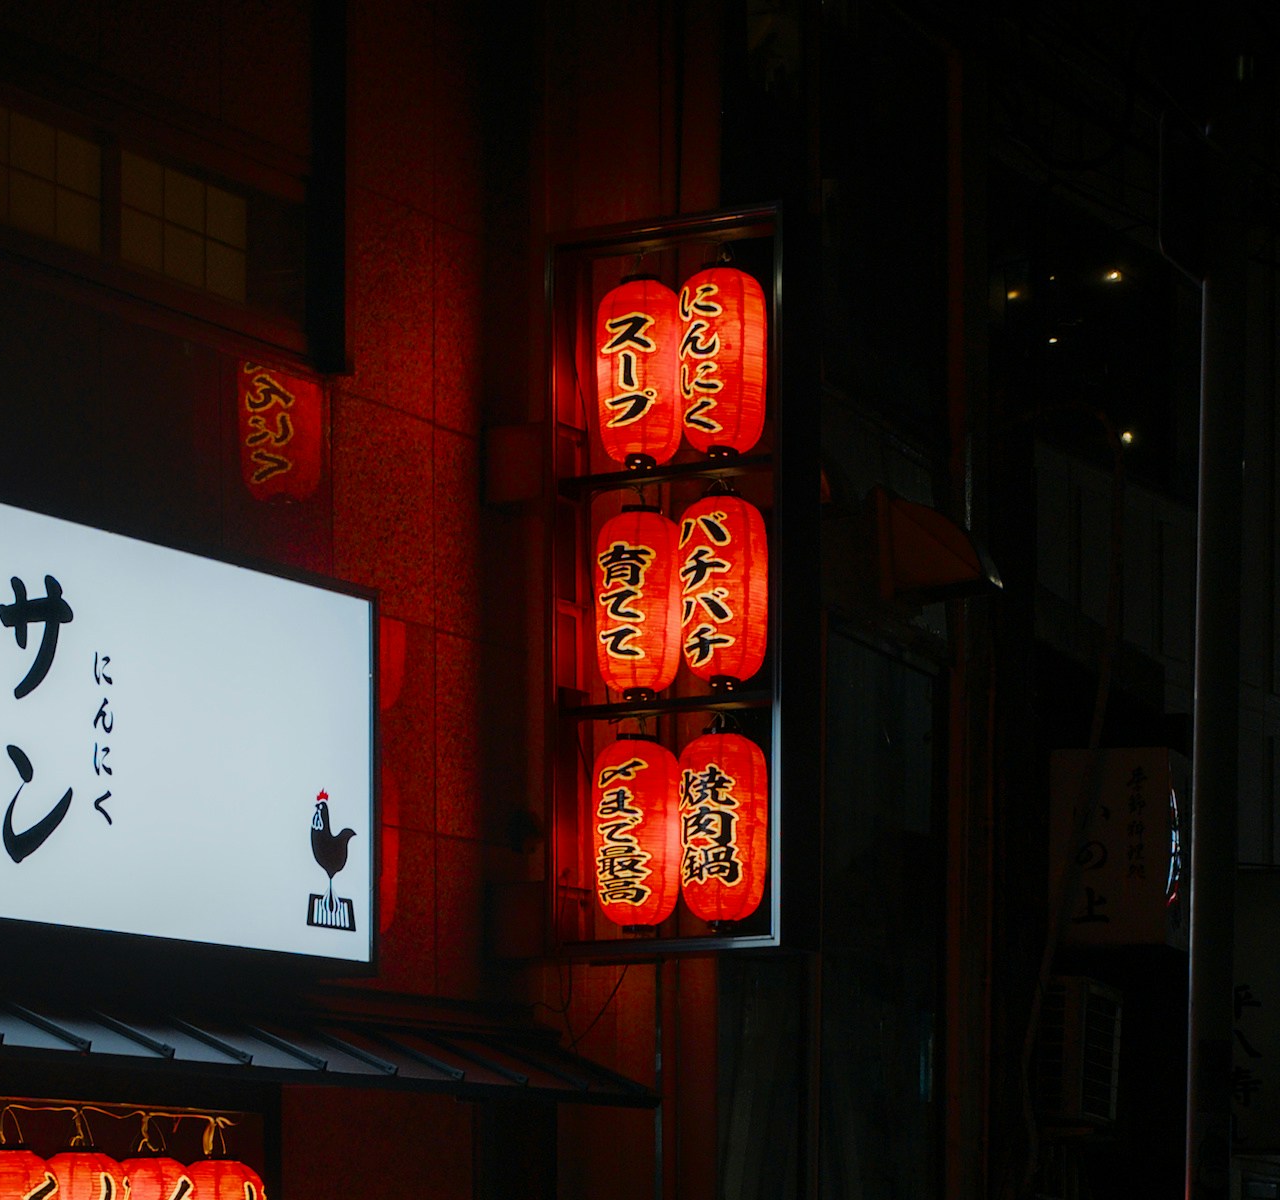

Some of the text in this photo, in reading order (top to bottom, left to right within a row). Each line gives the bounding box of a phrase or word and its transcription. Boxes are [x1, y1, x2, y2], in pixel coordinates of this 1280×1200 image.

[601, 312, 658, 429] スープ
[679, 284, 724, 433] にんにく
[597, 541, 657, 660] 育てて
[679, 511, 736, 667] バチバチ
[93, 651, 114, 825] にんにく
[679, 763, 743, 887] 焼肉鍋
